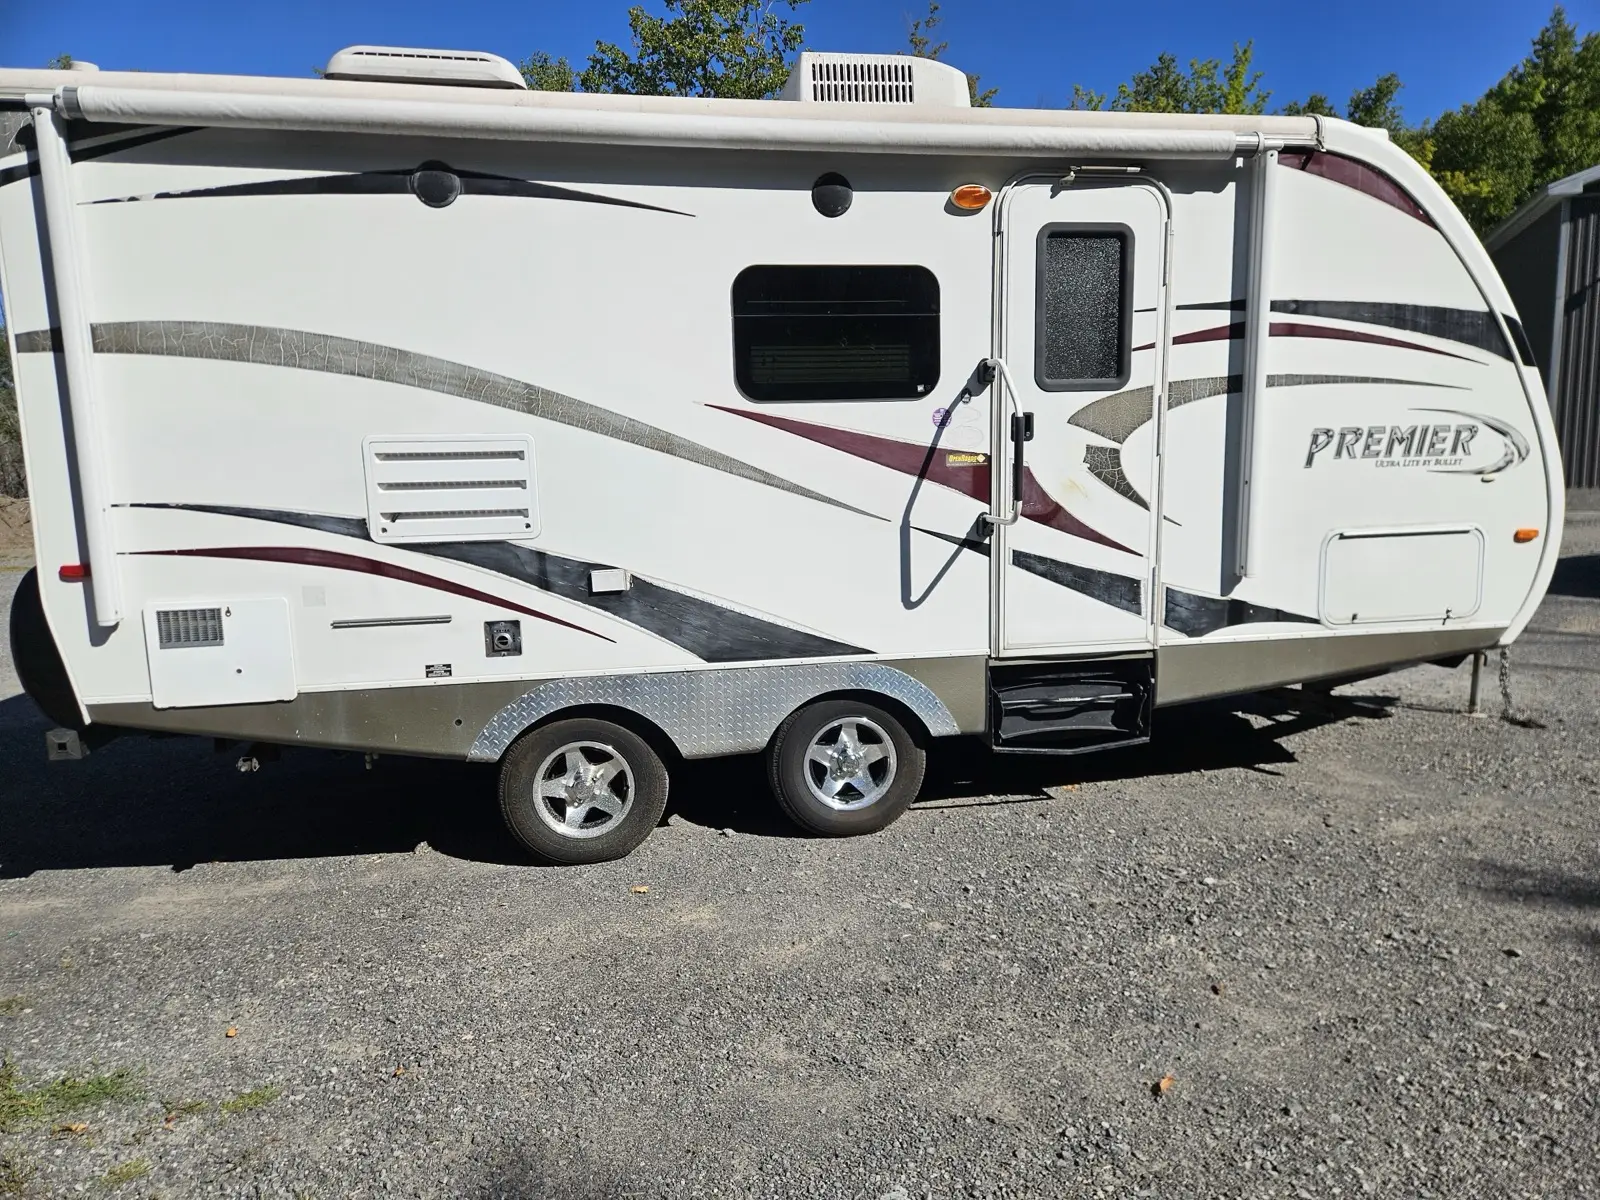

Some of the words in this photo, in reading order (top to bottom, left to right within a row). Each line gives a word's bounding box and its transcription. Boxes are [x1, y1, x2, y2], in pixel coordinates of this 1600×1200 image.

[1303, 424, 1479, 468] PREMIER
[1375, 459, 1400, 468] ULTRA
[1402, 458, 1420, 467] LITE
[1434, 457, 1463, 466] BULLET
